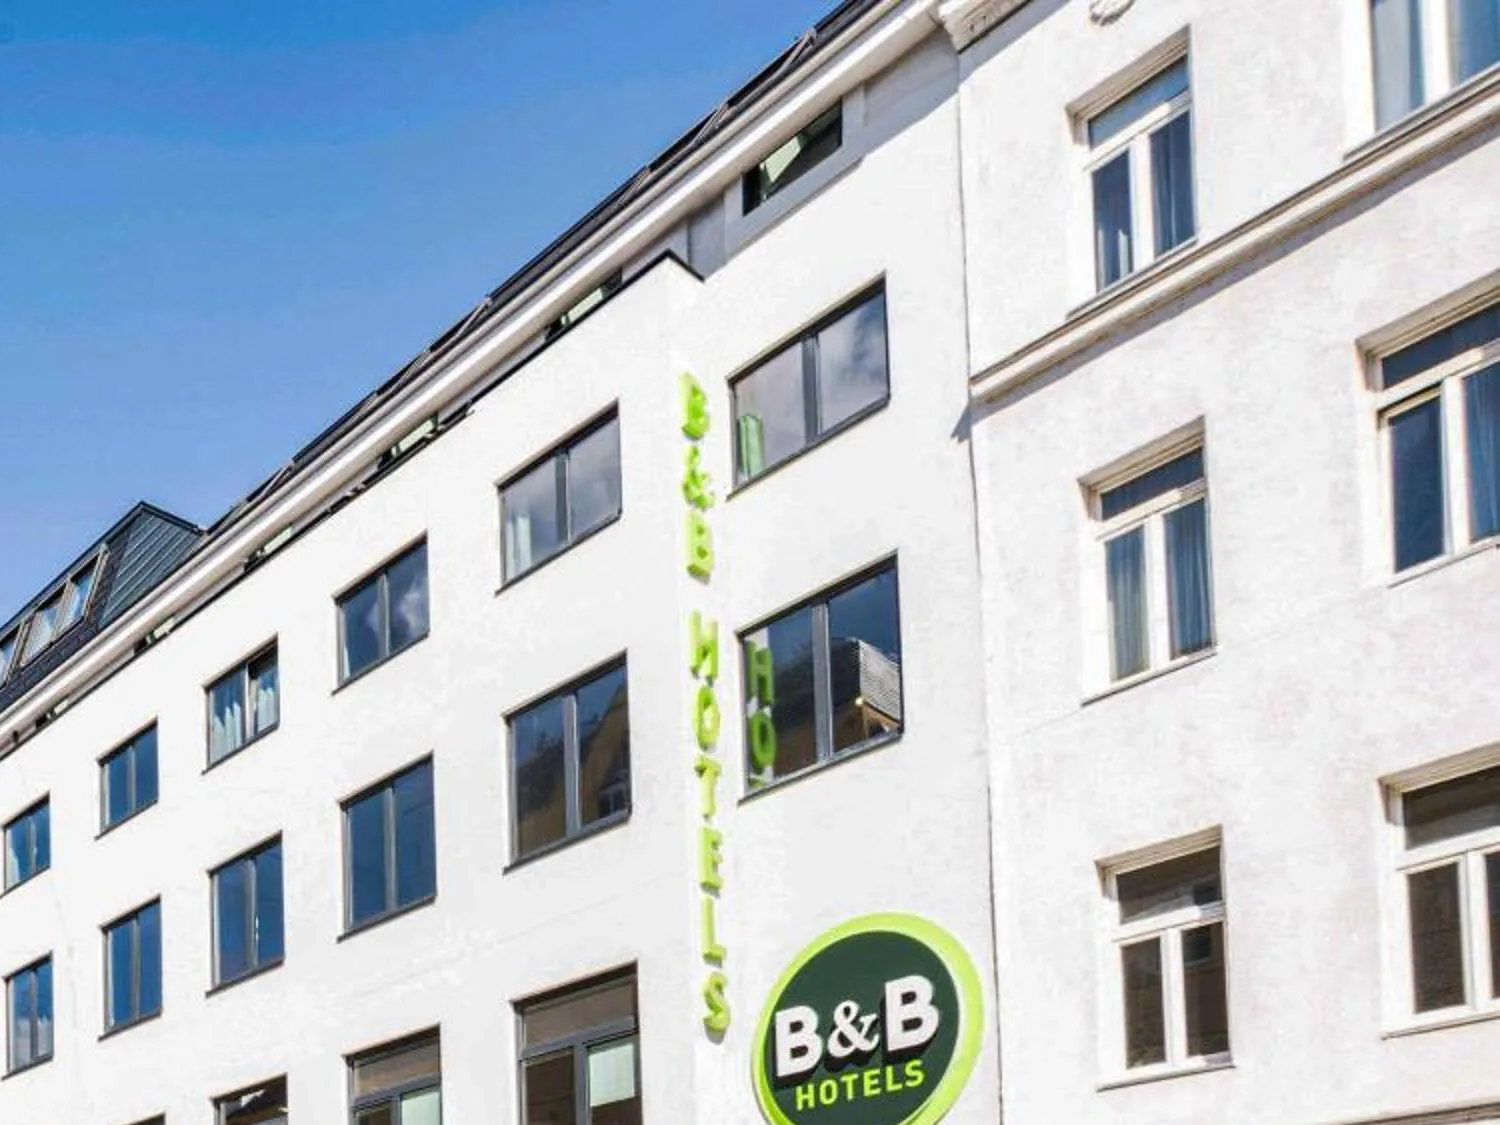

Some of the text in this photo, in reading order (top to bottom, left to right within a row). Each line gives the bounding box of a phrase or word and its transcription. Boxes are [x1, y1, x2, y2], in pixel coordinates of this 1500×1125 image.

[680, 371, 731, 1031] B&B HOTELS
[775, 975, 940, 1077] B&B
[795, 1058, 925, 1111] HOTELS
